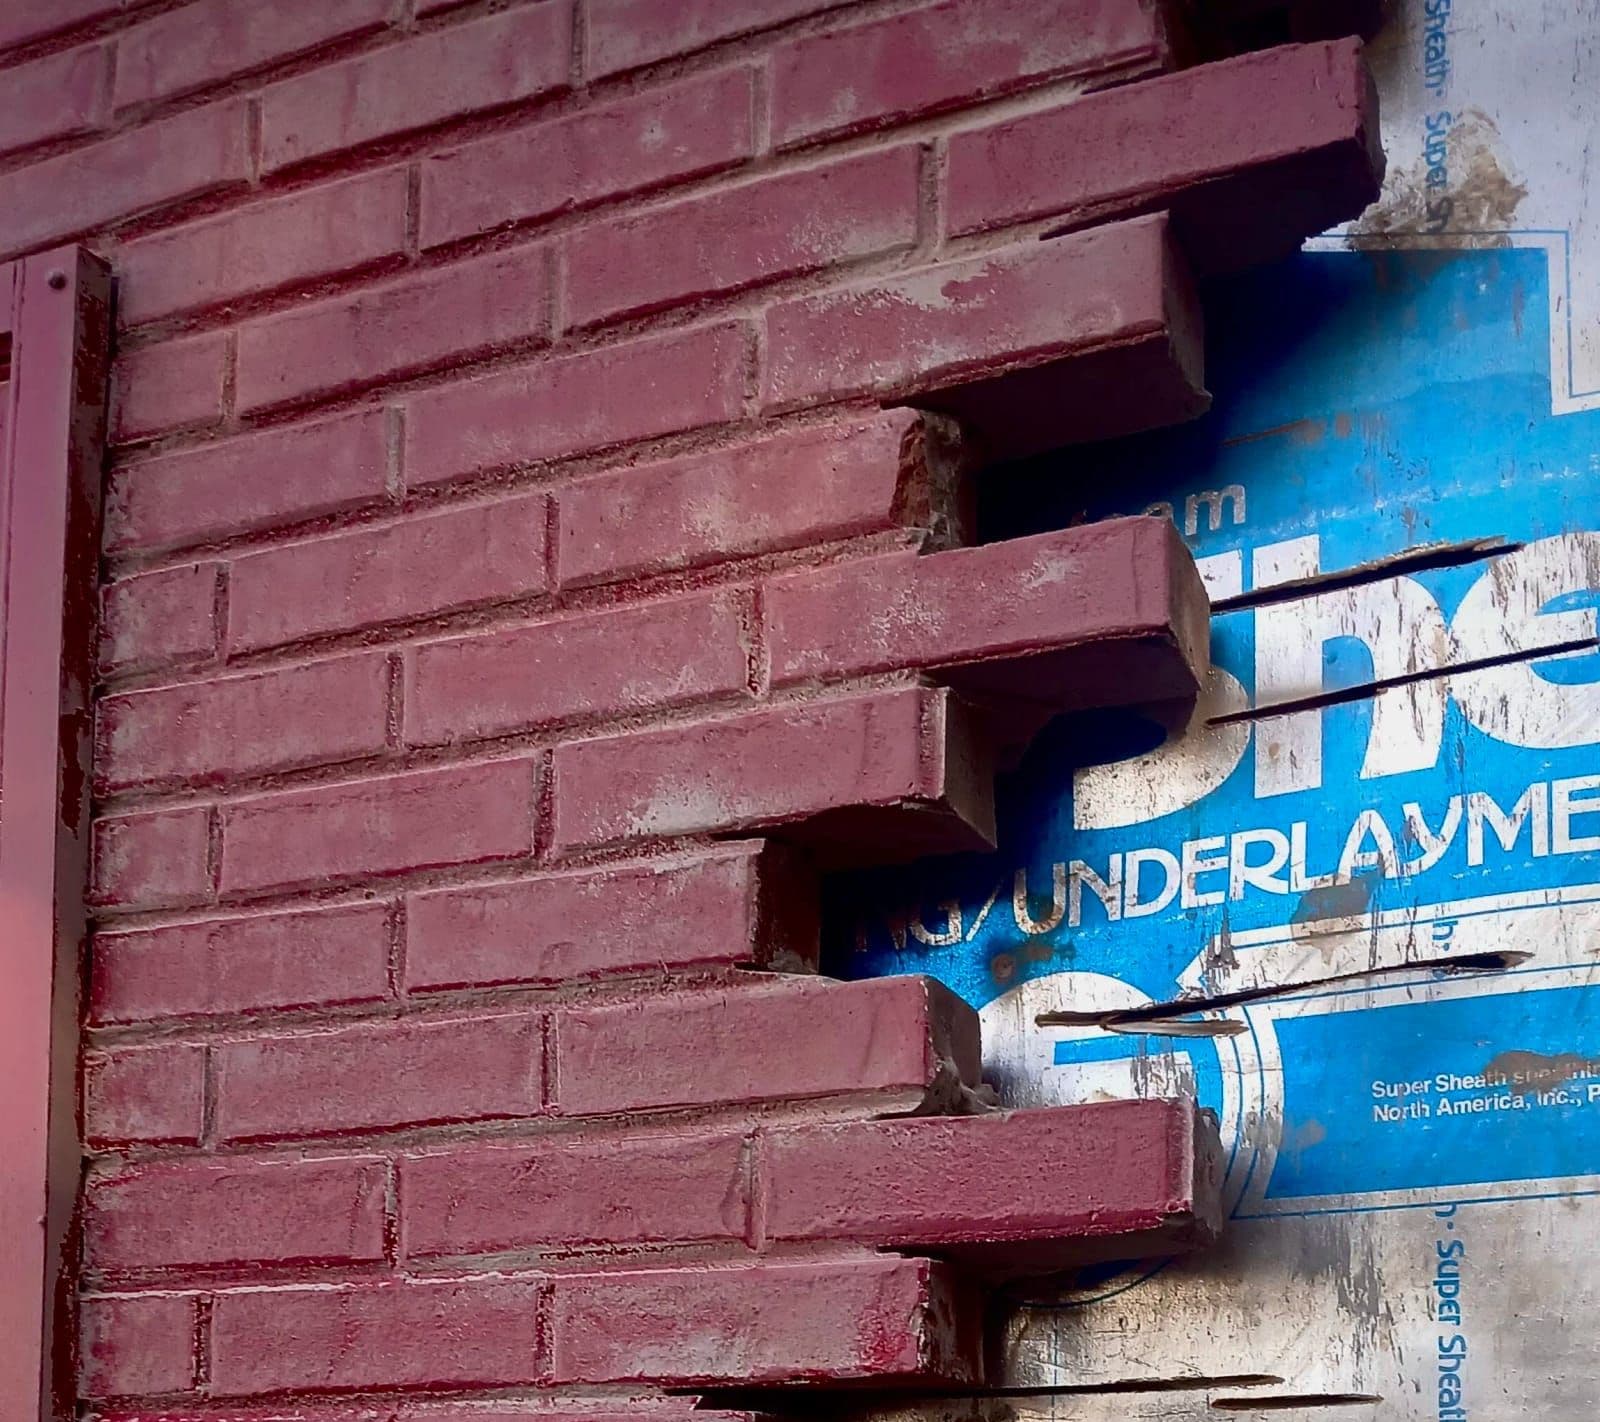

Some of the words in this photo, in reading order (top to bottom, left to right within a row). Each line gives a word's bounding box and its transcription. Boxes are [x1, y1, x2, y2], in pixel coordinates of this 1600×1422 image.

[1371, 1080, 1432, 1098] Super
[1435, 1071, 1507, 1092] Sheath
[1373, 1101, 1430, 1122] North
[1436, 1091, 1532, 1116] America,
[1433, 1239, 1464, 1326] Super
